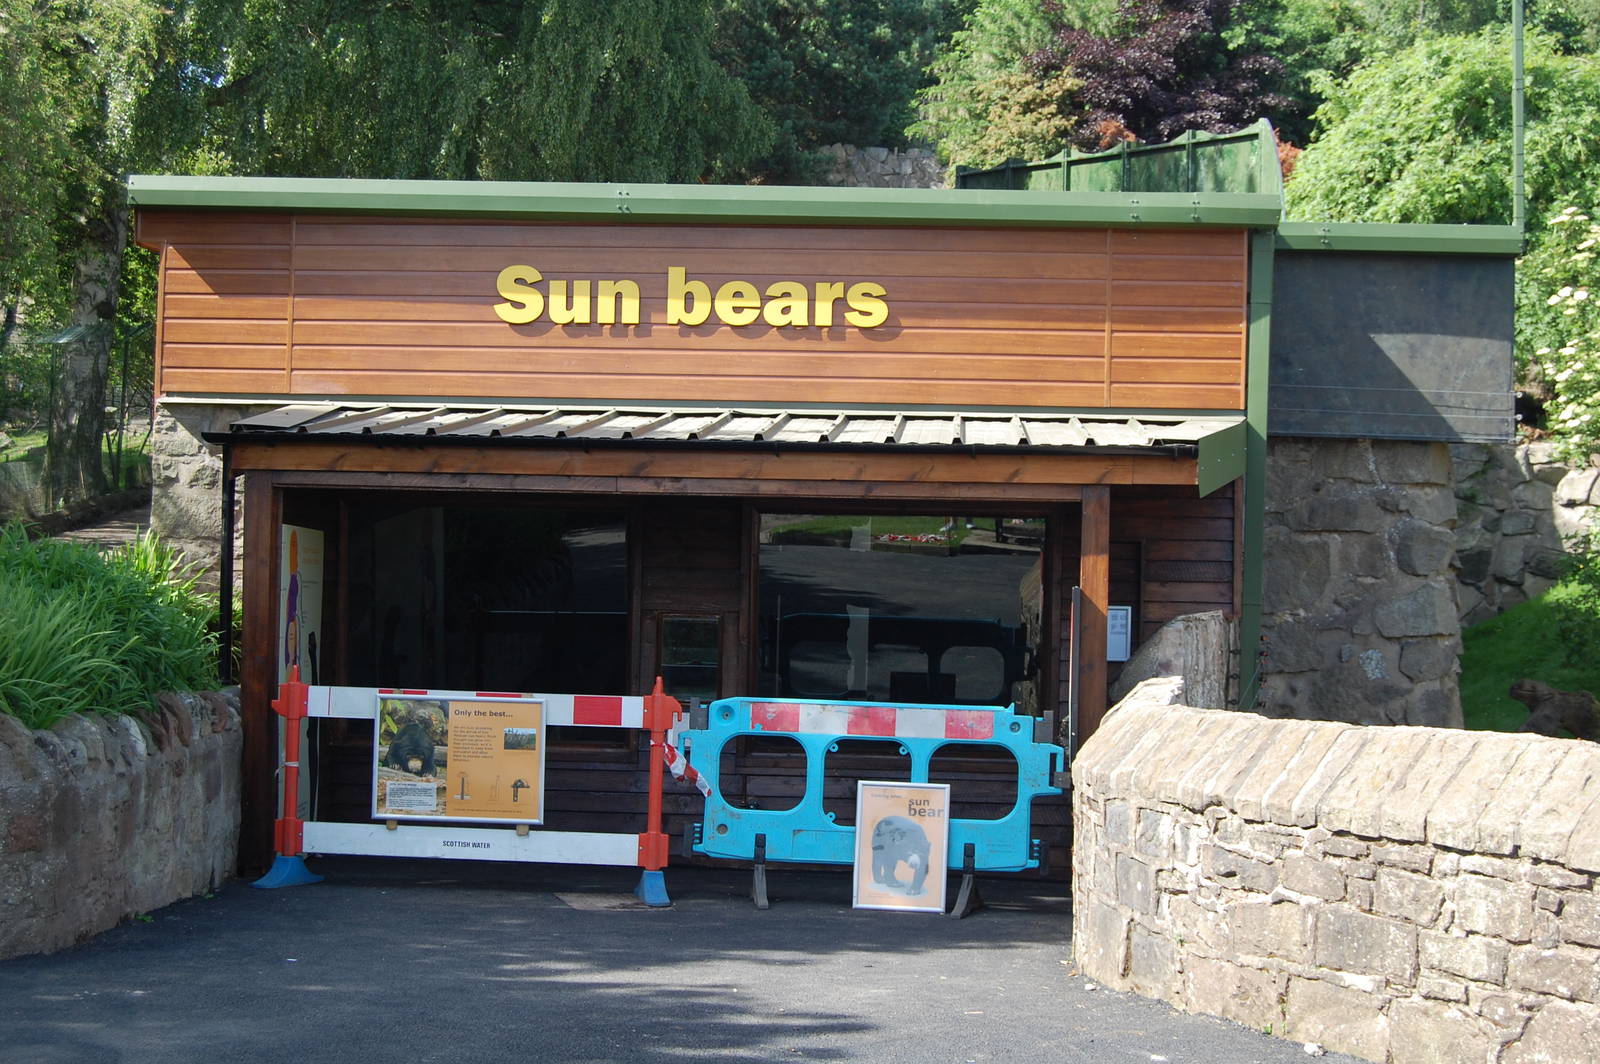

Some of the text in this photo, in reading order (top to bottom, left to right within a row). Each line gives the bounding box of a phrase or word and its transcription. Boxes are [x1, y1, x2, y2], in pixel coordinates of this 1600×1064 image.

[493, 264, 889, 328] Sun bears
[454, 709, 472, 717] Only
[489, 710, 514, 718] best...
[908, 803, 944, 817] bear
[442, 840, 491, 849] SCOTTISH WATER
